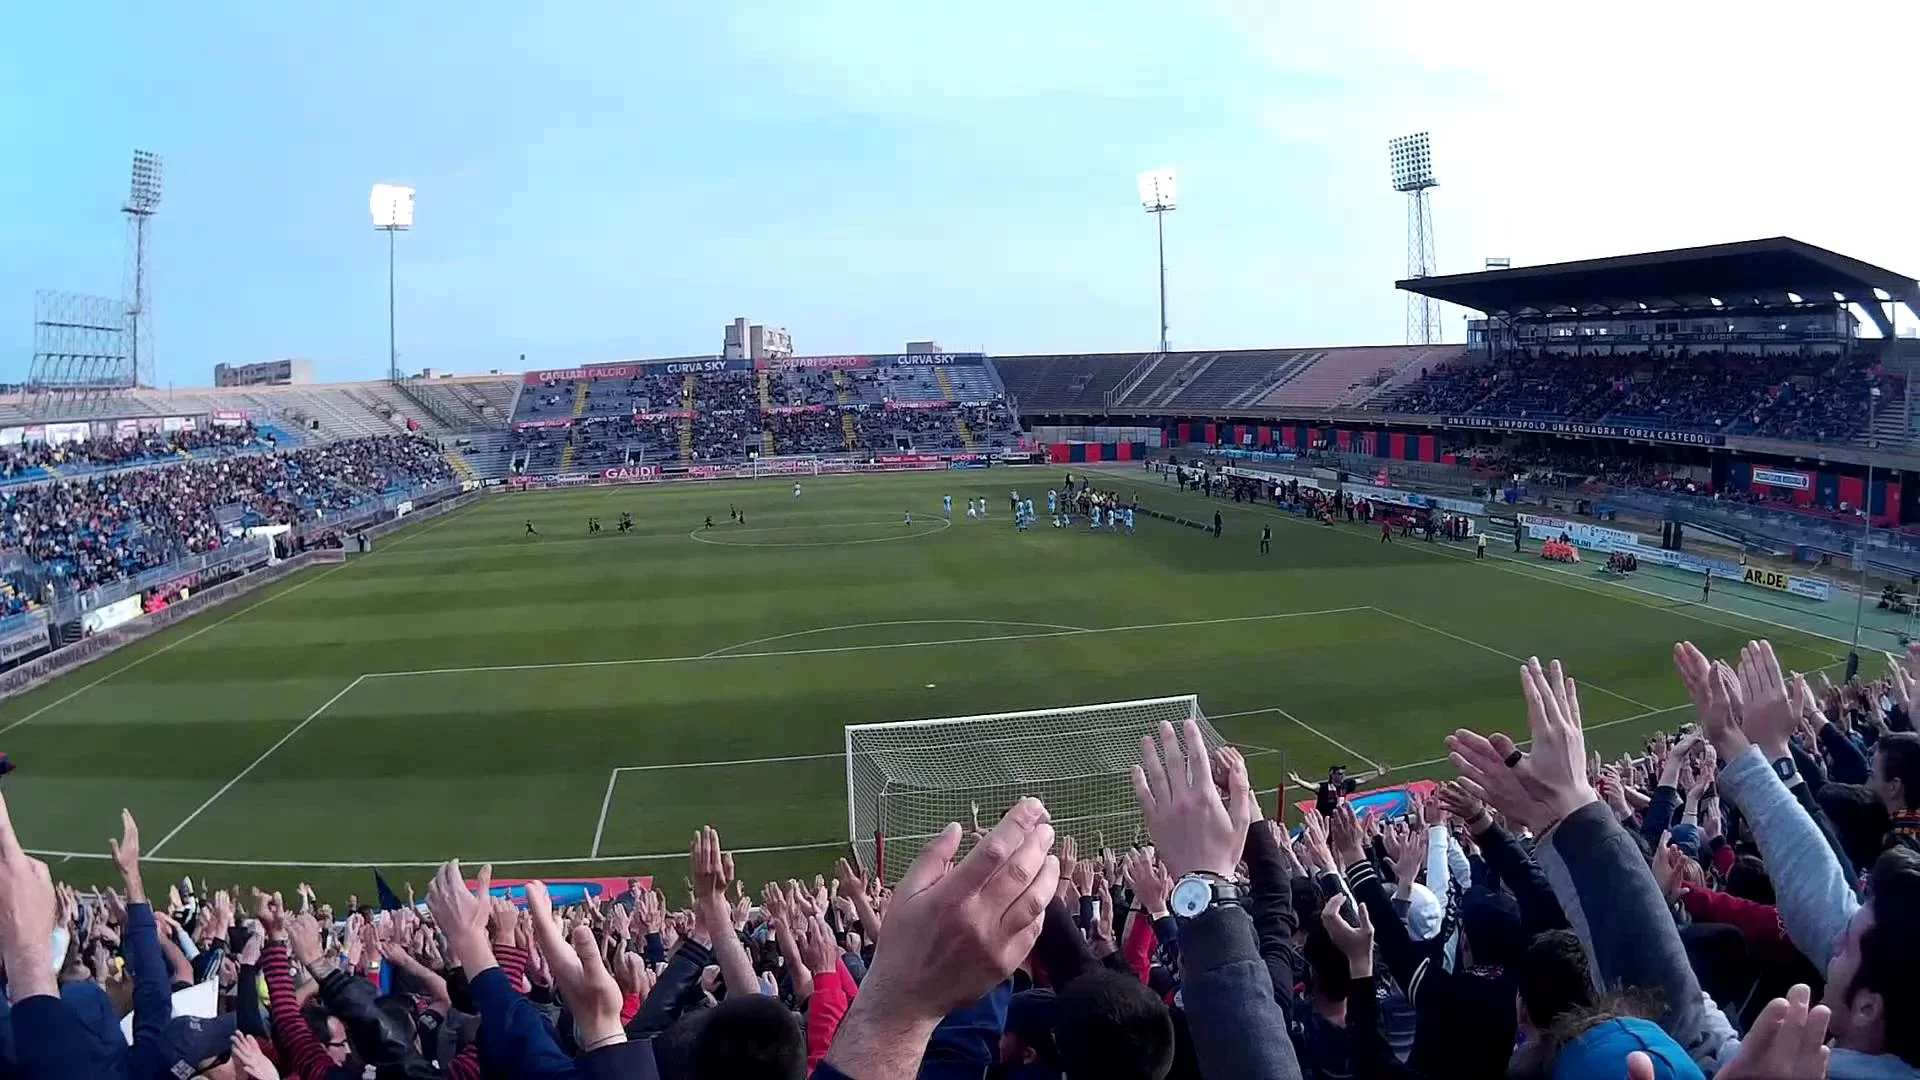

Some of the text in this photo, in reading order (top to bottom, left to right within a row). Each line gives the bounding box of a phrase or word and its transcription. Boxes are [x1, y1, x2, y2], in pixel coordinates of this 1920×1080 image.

[817, 356, 857, 367] CALCIO
[897, 354, 956, 365] CURVA SKY
[540, 367, 626, 381] CAGLIARI CALCIO
[667, 361, 726, 374] CURVA SKY
[1499, 419, 1510, 428] UN
[1552, 423, 1570, 432] UNA
[1572, 424, 1616, 436] SQUADRA
[1623, 427, 1655, 439] FORZA
[1657, 431, 1711, 444] CASTEDDU
[1744, 568, 1786, 589] AR.DE.
